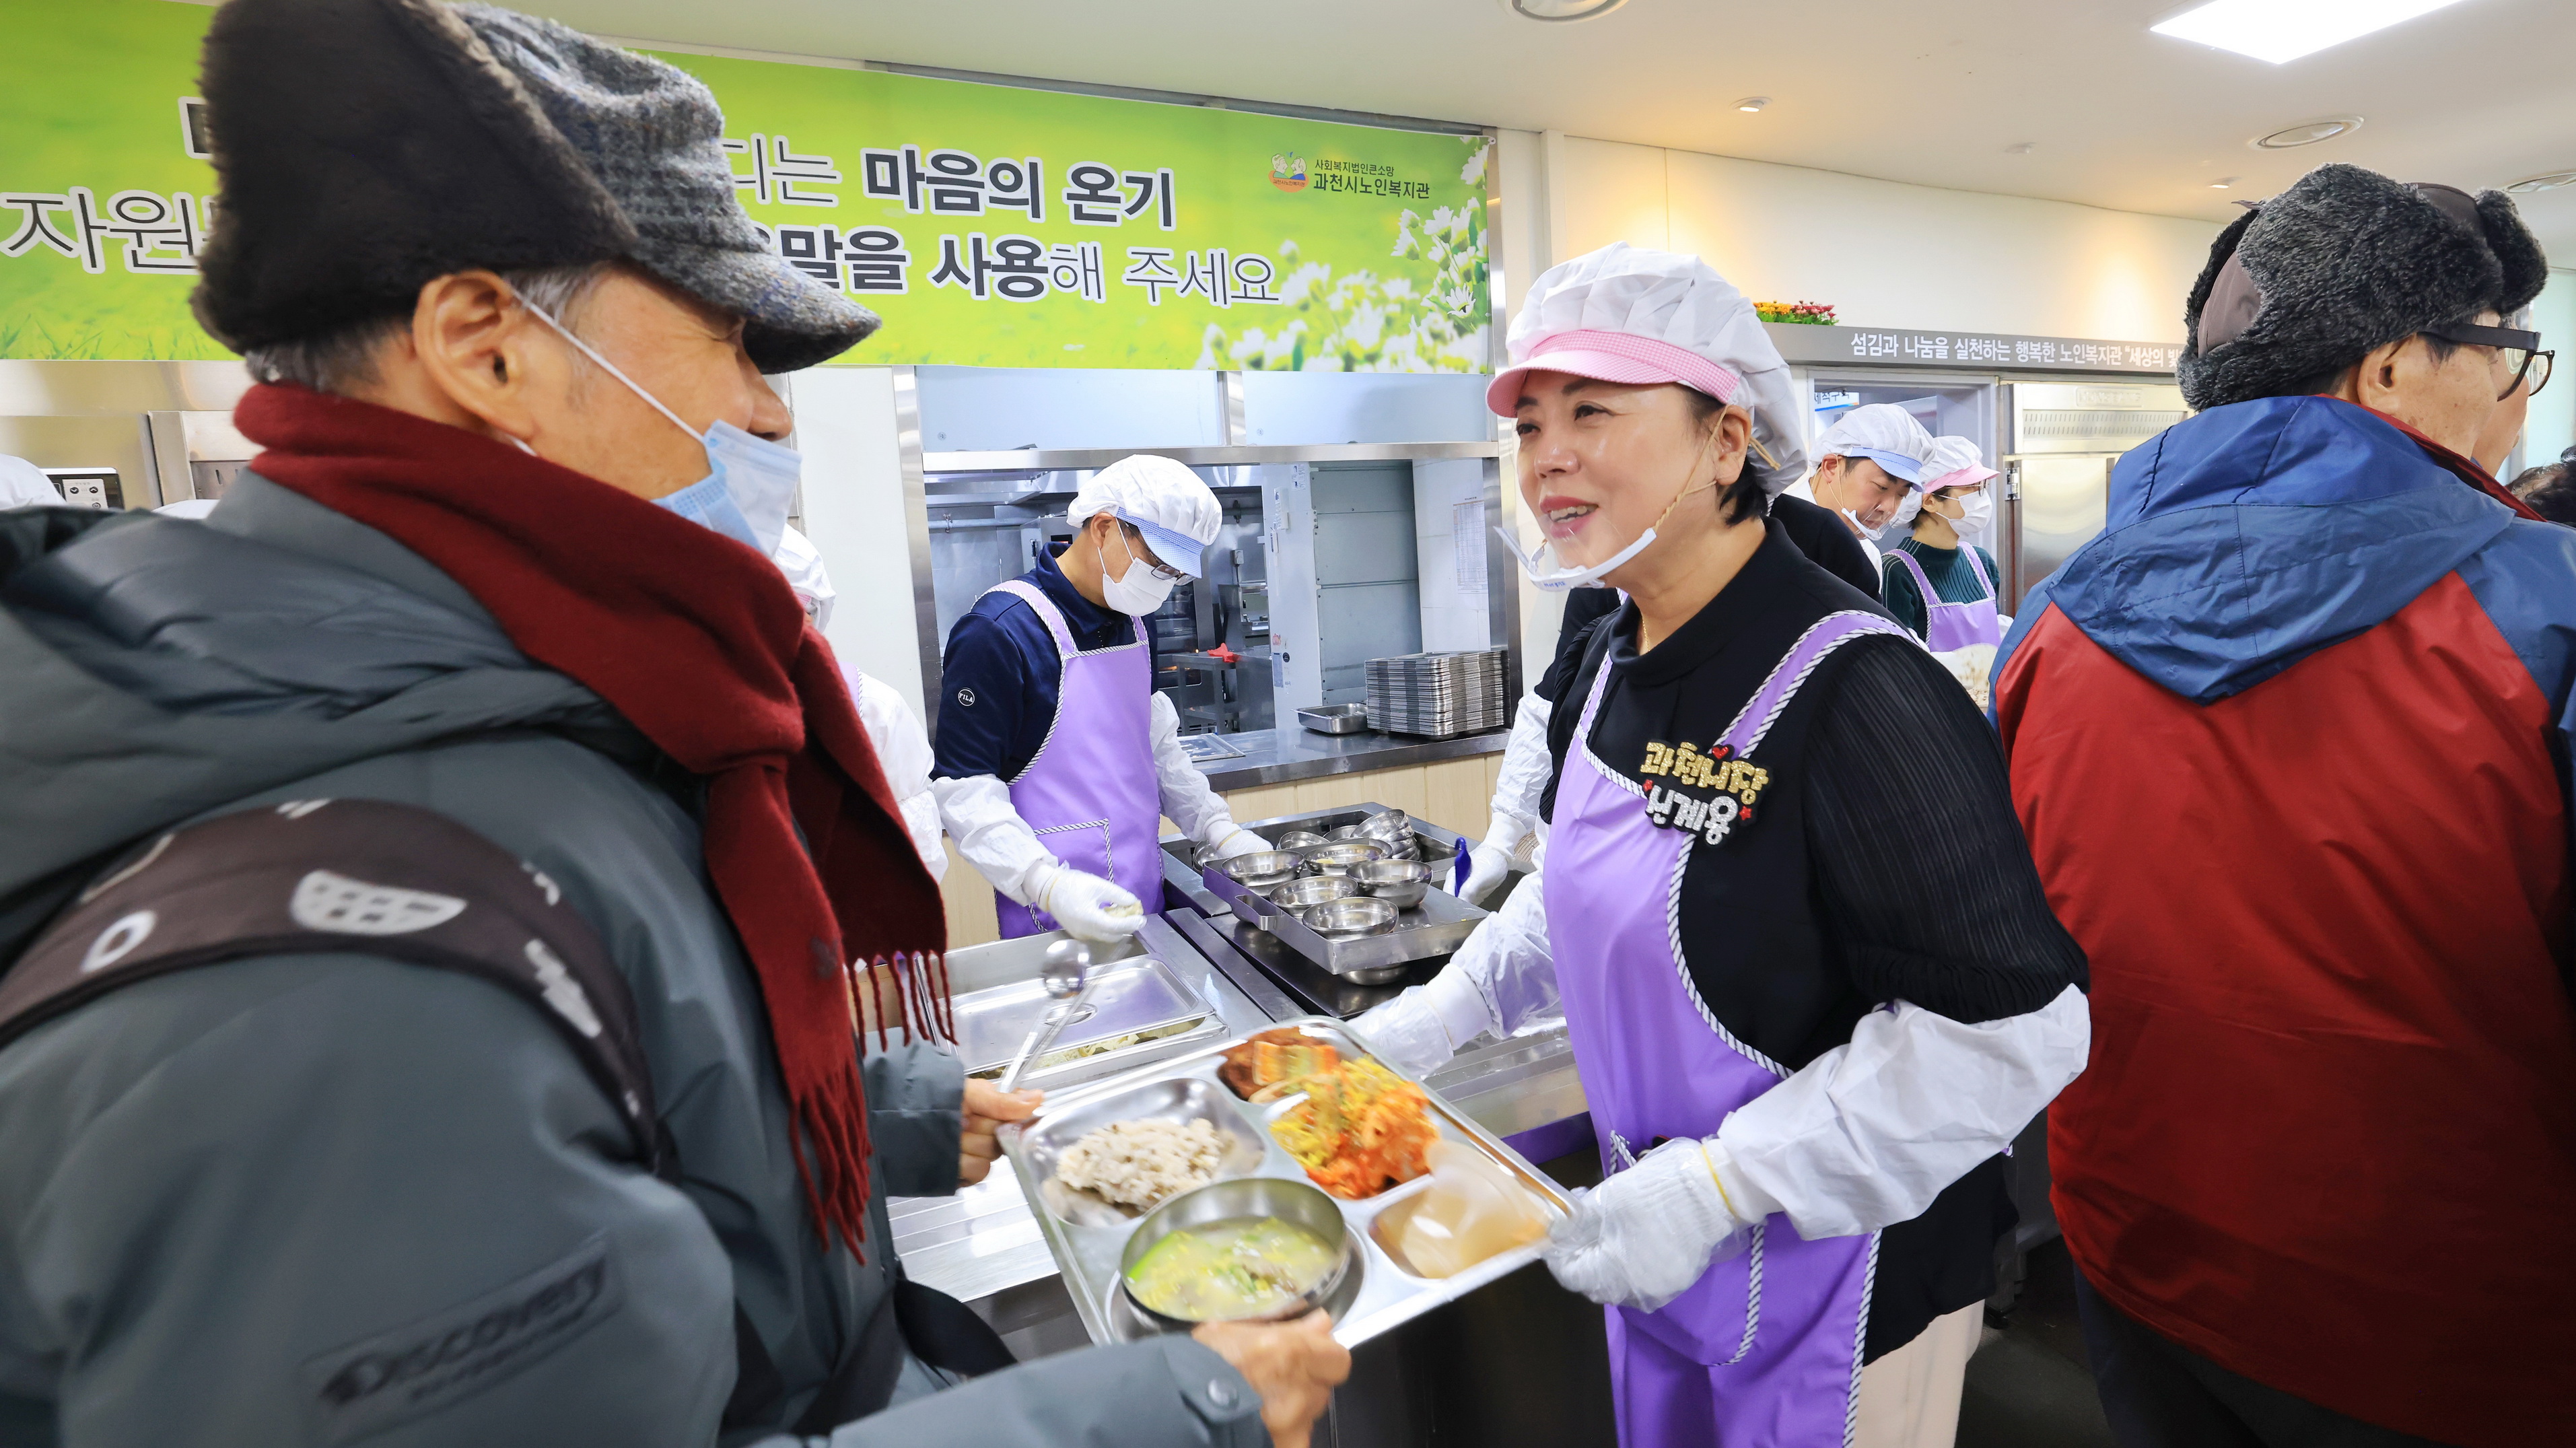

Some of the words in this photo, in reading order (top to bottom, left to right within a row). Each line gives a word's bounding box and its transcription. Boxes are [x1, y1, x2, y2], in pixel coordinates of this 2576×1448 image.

[865, 149, 1043, 219] 마음의
[1066, 166, 1174, 229] 온기
[1313, 173, 1430, 199] 과천시노인복지관
[1315, 159, 1395, 177] 사회복지법인큰소망
[5, 193, 217, 269] 자원
[754, 226, 907, 291] 말을
[932, 237, 1102, 300] 사용해
[1125, 251, 1279, 306] 주세요
[1850, 333, 1900, 357] 섬김과
[1904, 335, 1949, 359] 나눔을
[1955, 338, 2011, 361] 실천하는
[2015, 341, 2056, 363] 행복한
[2060, 343, 2122, 366] 노인복지관
[2167, 349, 2183, 368] 빛
[959, 693, 974, 703] FILA
[1640, 741, 1770, 806] 과천시장
[1644, 784, 1739, 846] 신계용
